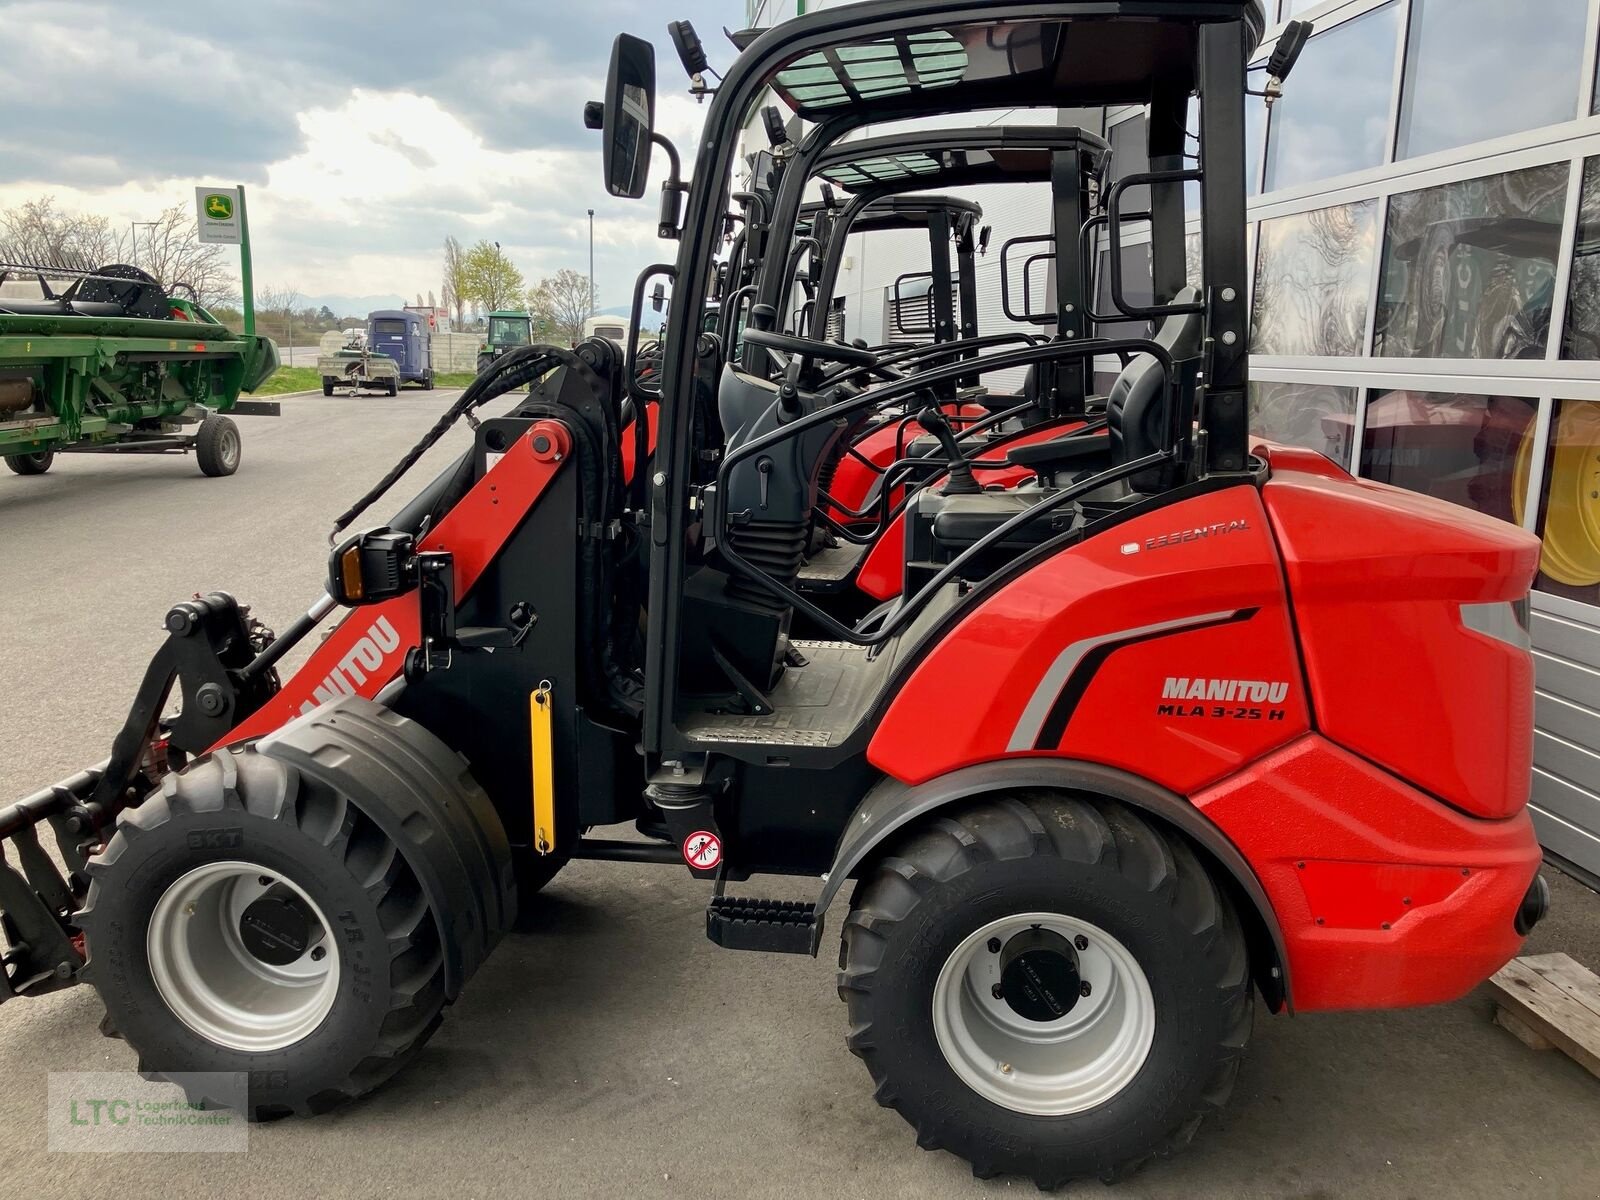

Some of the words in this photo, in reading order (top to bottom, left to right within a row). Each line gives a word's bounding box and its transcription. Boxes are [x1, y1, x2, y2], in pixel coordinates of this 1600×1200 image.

[1145, 519, 1250, 550] ESSENTIAL
[1162, 677, 1289, 704] MANITOU
[1157, 704, 1205, 717] MLA
[1211, 706, 1262, 720] 3-25
[1269, 709, 1285, 721] H
